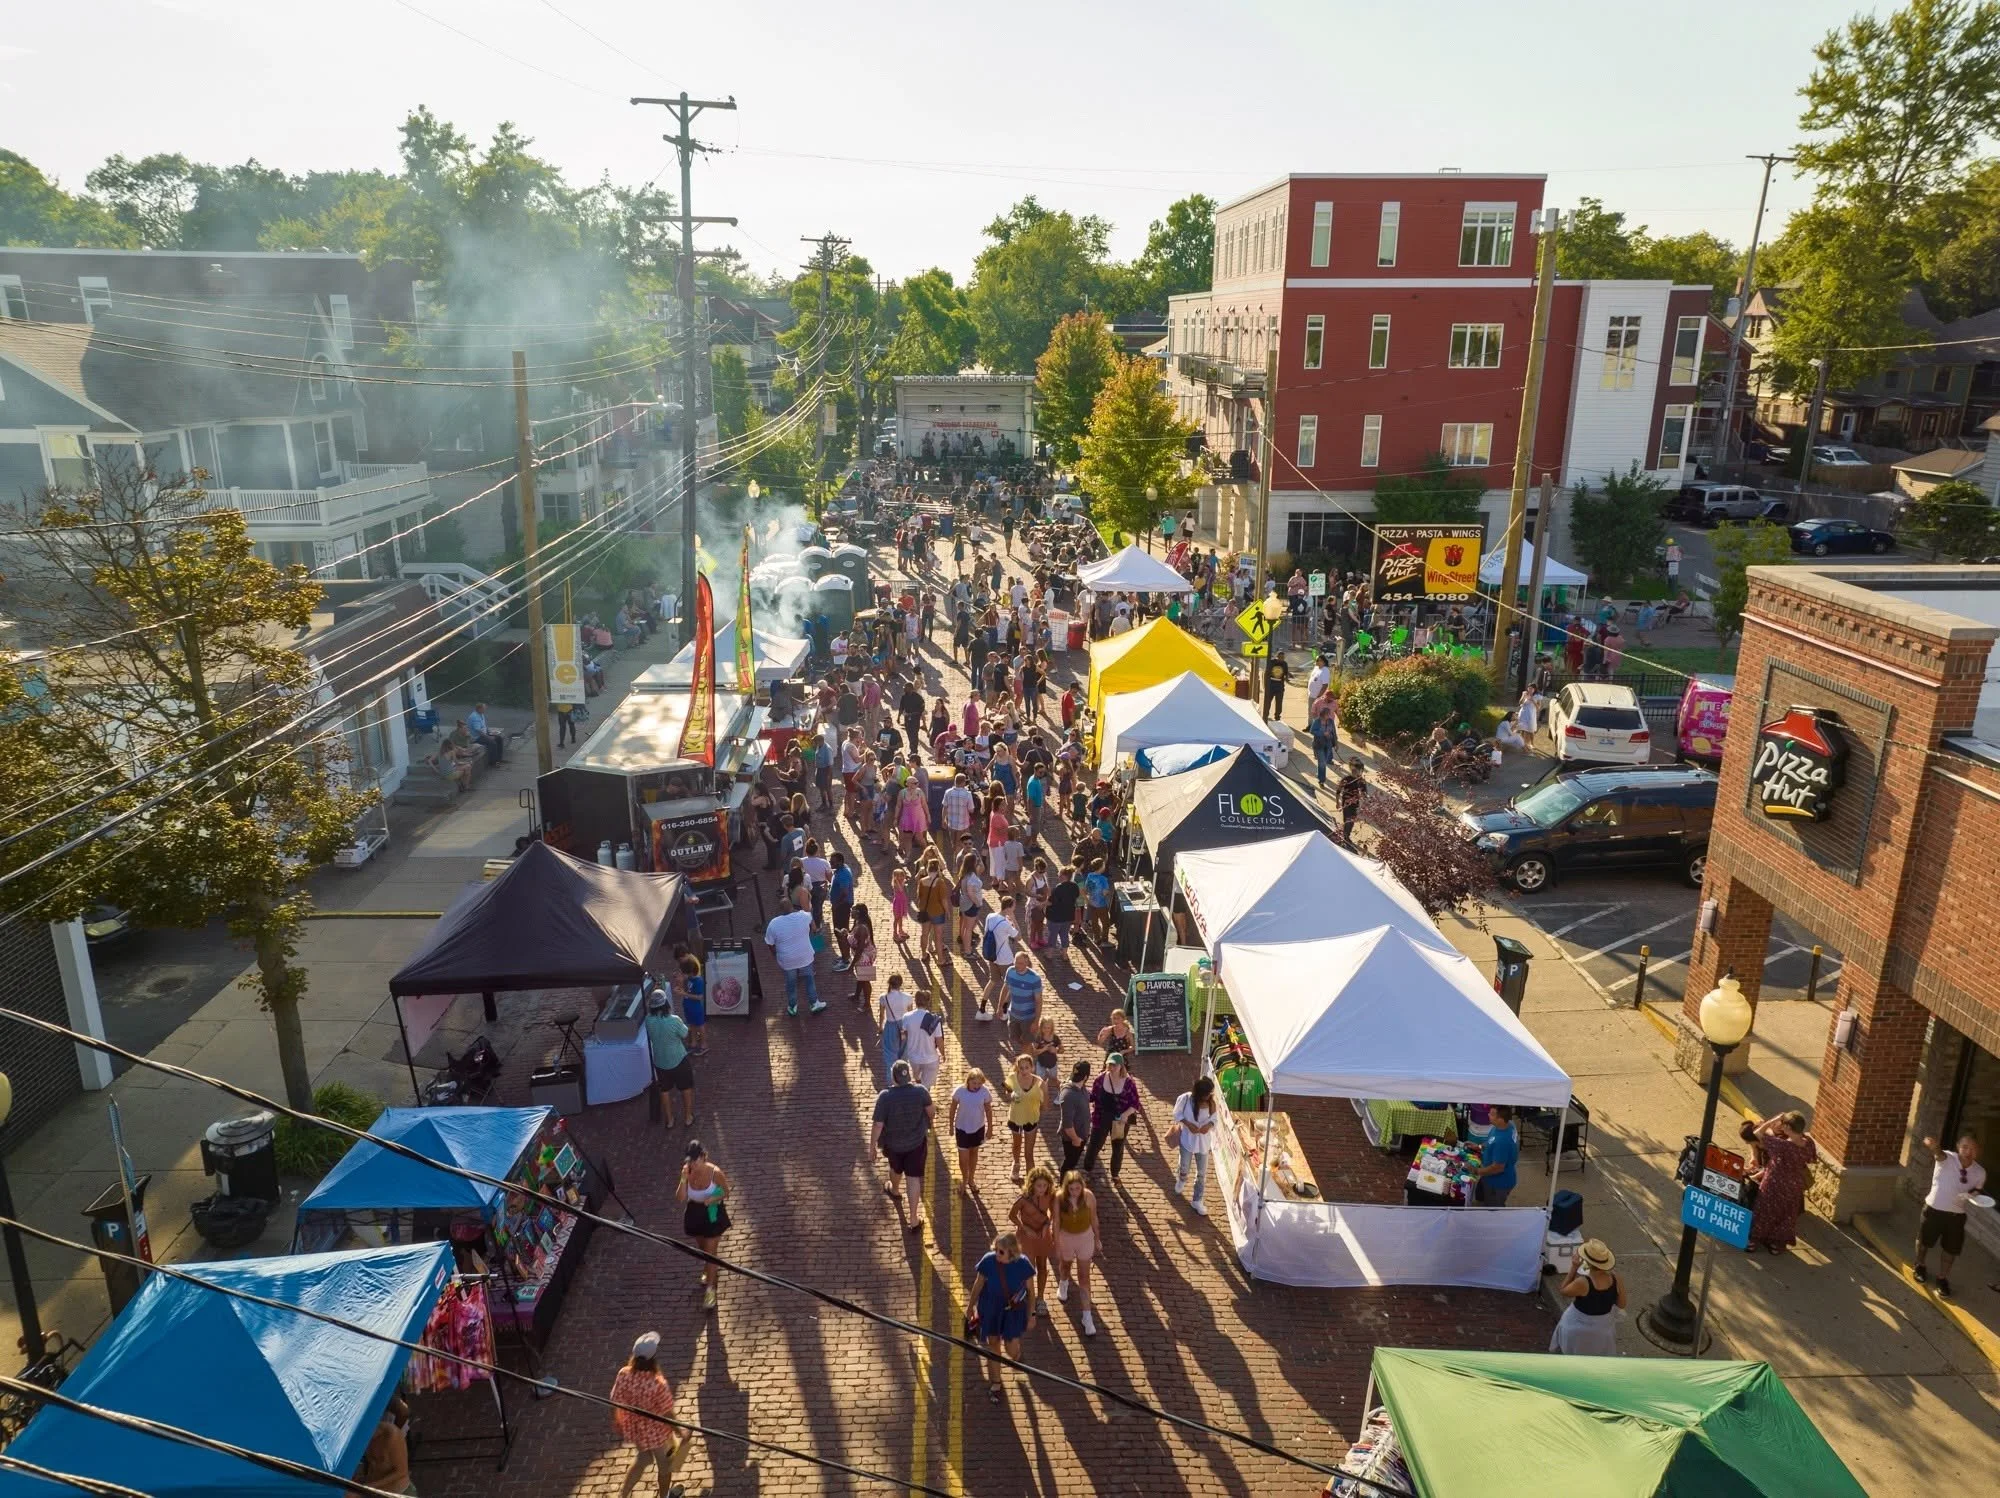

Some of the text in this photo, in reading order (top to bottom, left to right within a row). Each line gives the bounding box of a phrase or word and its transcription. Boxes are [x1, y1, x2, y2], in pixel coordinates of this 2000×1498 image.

[1381, 529, 1481, 538] PIZZA PASTA WINGS
[1379, 557, 1424, 575] Pizza
[1386, 565, 1417, 580] Hut
[1427, 571, 1477, 585] WingStreet
[1381, 593, 1469, 601] 454-4080
[1753, 741, 1828, 785] Pizza
[1762, 771, 1817, 809] Hut
[1220, 815, 1285, 825] COLLECTION
[670, 844, 713, 857] OUTLAW
[1510, 965, 1518, 976] P
[1146, 981, 1176, 990] FLAVORS
[1690, 1190, 1746, 1224] PAY HERE
[1692, 1204, 1740, 1235] TO PARK
[107, 1223, 119, 1237] P
